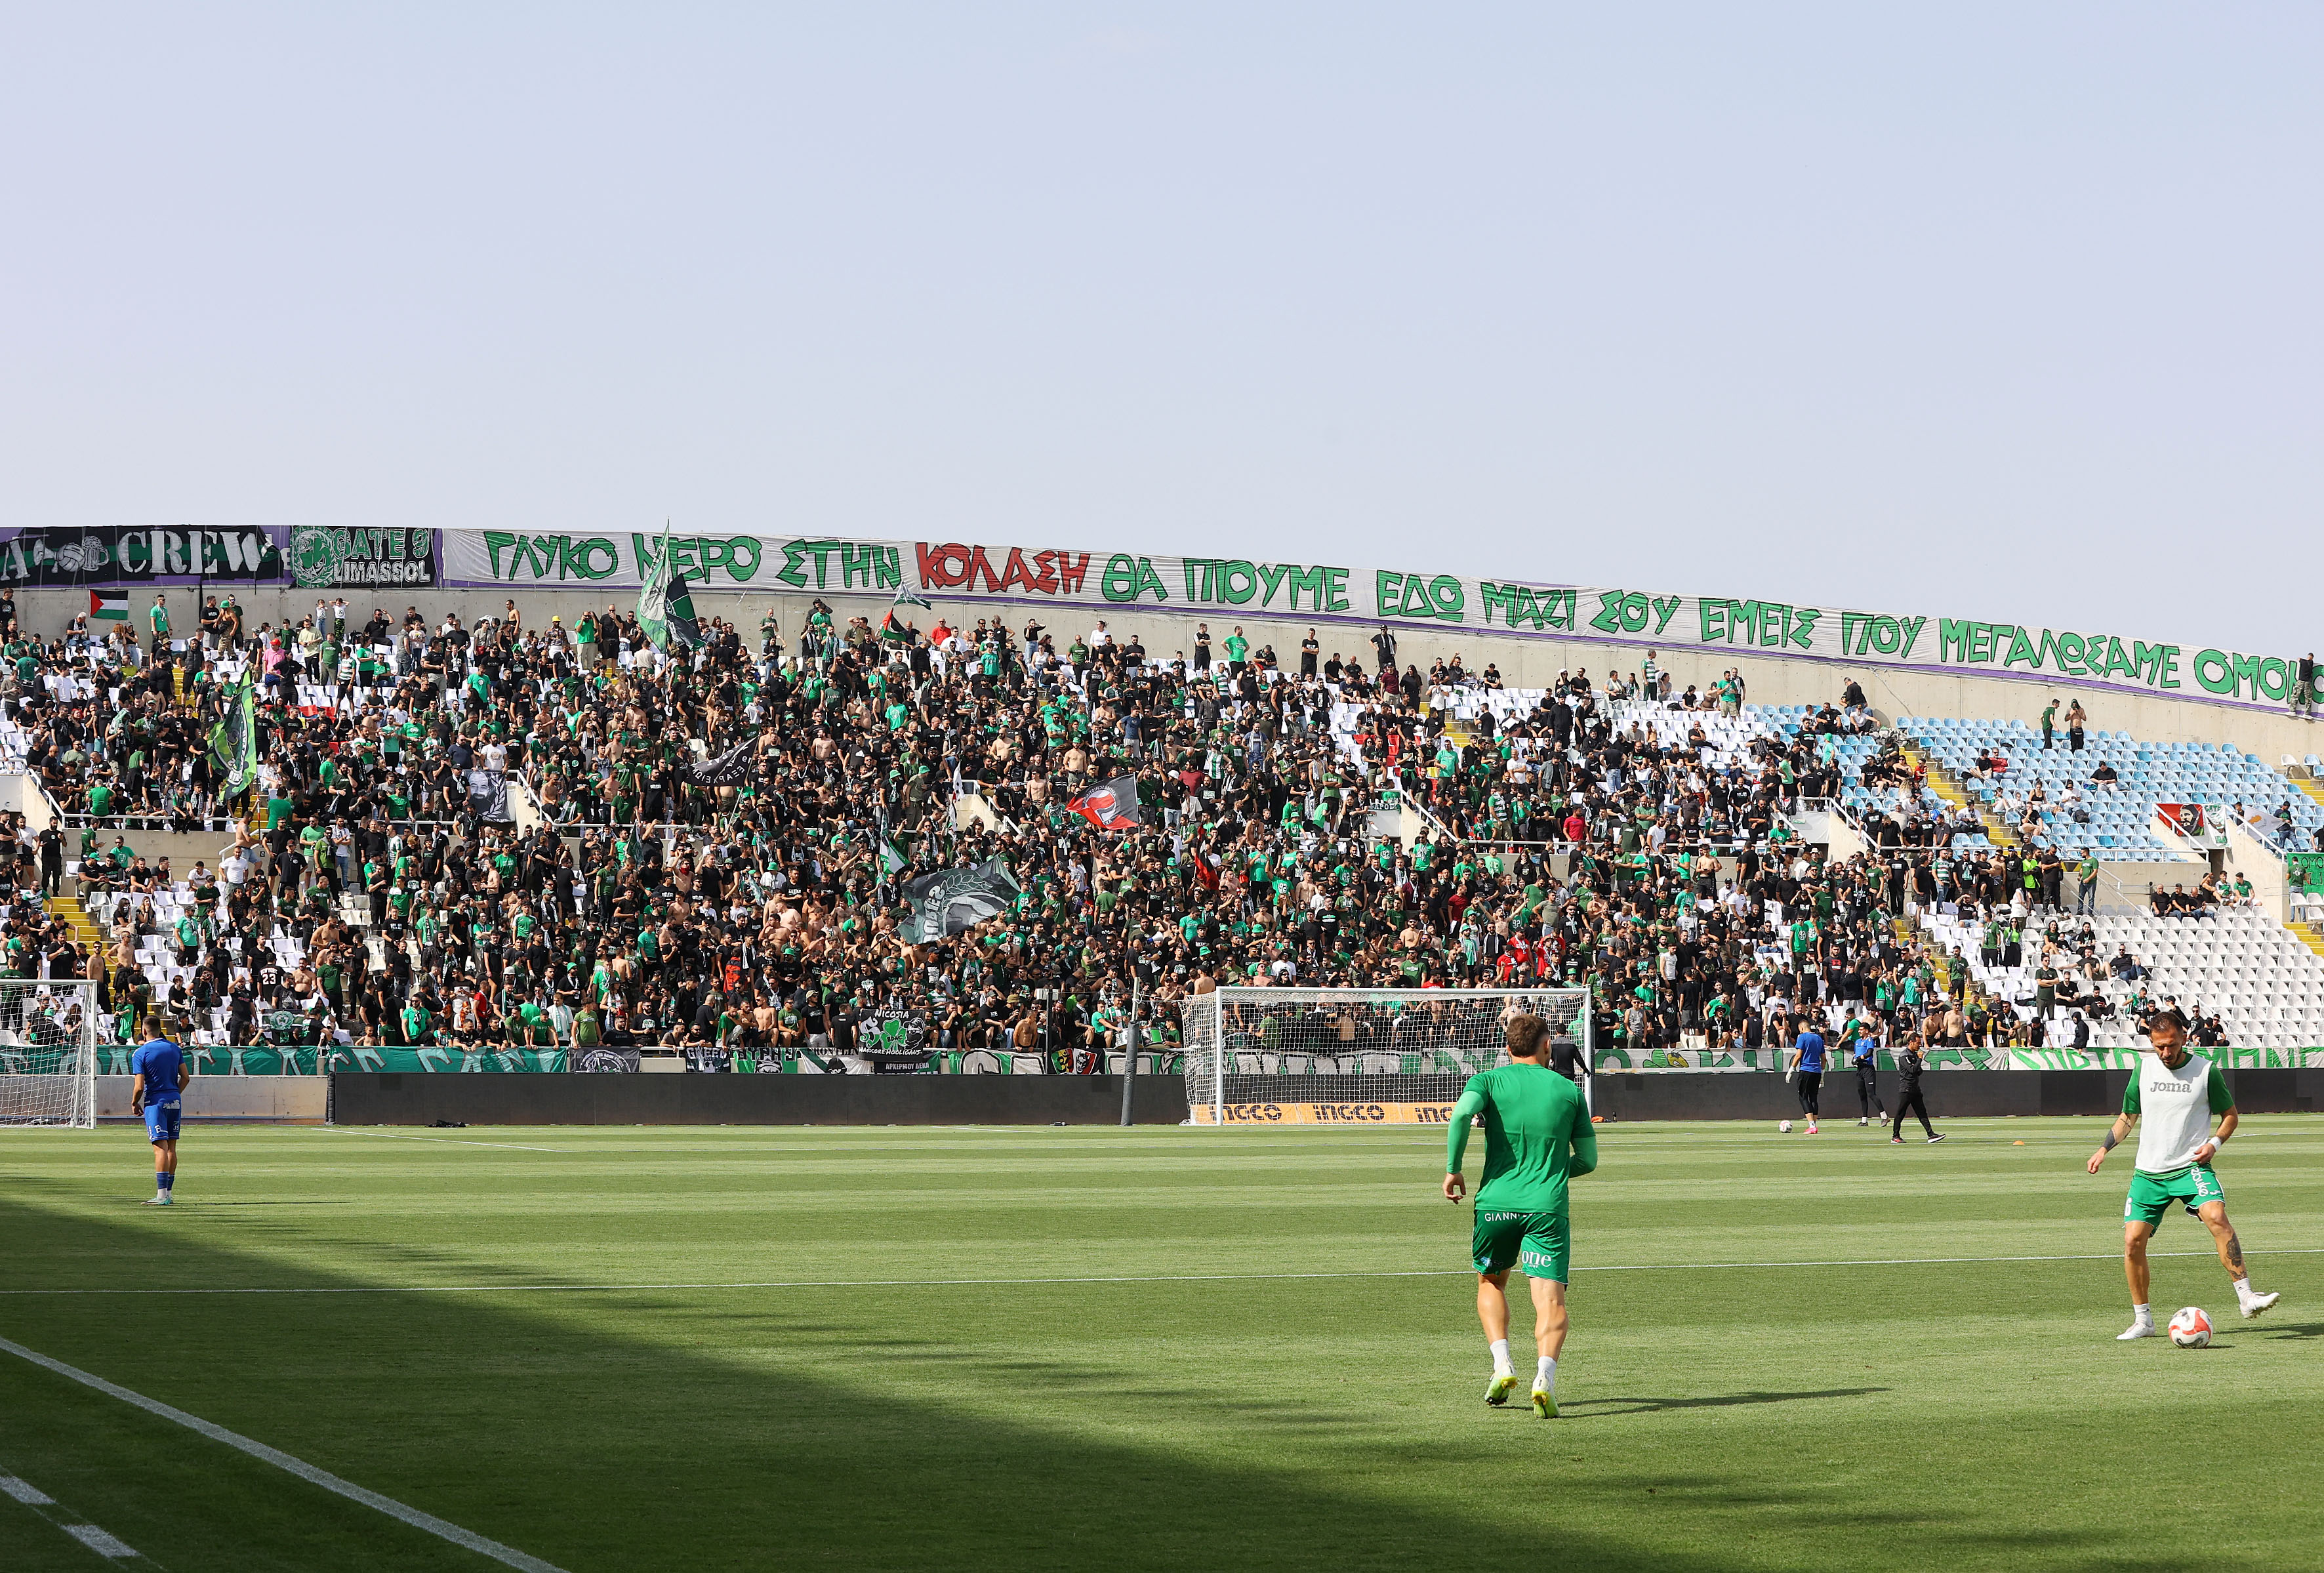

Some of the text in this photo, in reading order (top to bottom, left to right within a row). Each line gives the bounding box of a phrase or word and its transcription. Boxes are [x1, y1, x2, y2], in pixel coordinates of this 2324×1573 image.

[117, 530, 261, 574] CREW
[332, 527, 430, 560] GATE 9
[333, 561, 431, 583] LIMASSOL
[483, 531, 619, 581] ΓΛΥΚΟ
[632, 533, 762, 584] ΝΕΡΟ
[776, 538, 903, 590] ΣΤΗΝ
[915, 542, 1090, 595] ΚΟΛΑΣΗ
[1101, 553, 1169, 602] ΘΑ
[1183, 558, 1350, 611] ΠΙΟΥΜΕ
[1376, 569, 1465, 623] ΕΔΩ
[1480, 582, 1577, 631] ΜΑΖΙ
[1589, 589, 1682, 635] ΣΟΥ
[1698, 597, 1823, 650] ΕΜΕΙΣ
[1841, 612, 1926, 658] ΠΟΥ
[1940, 617, 2180, 688] ΜΕΓΑΛΩΣΑΜΕ
[262, 974, 276, 985] 23
[874, 1009, 910, 1019] NICOSIA
[1522, 1250, 1552, 1267] one
